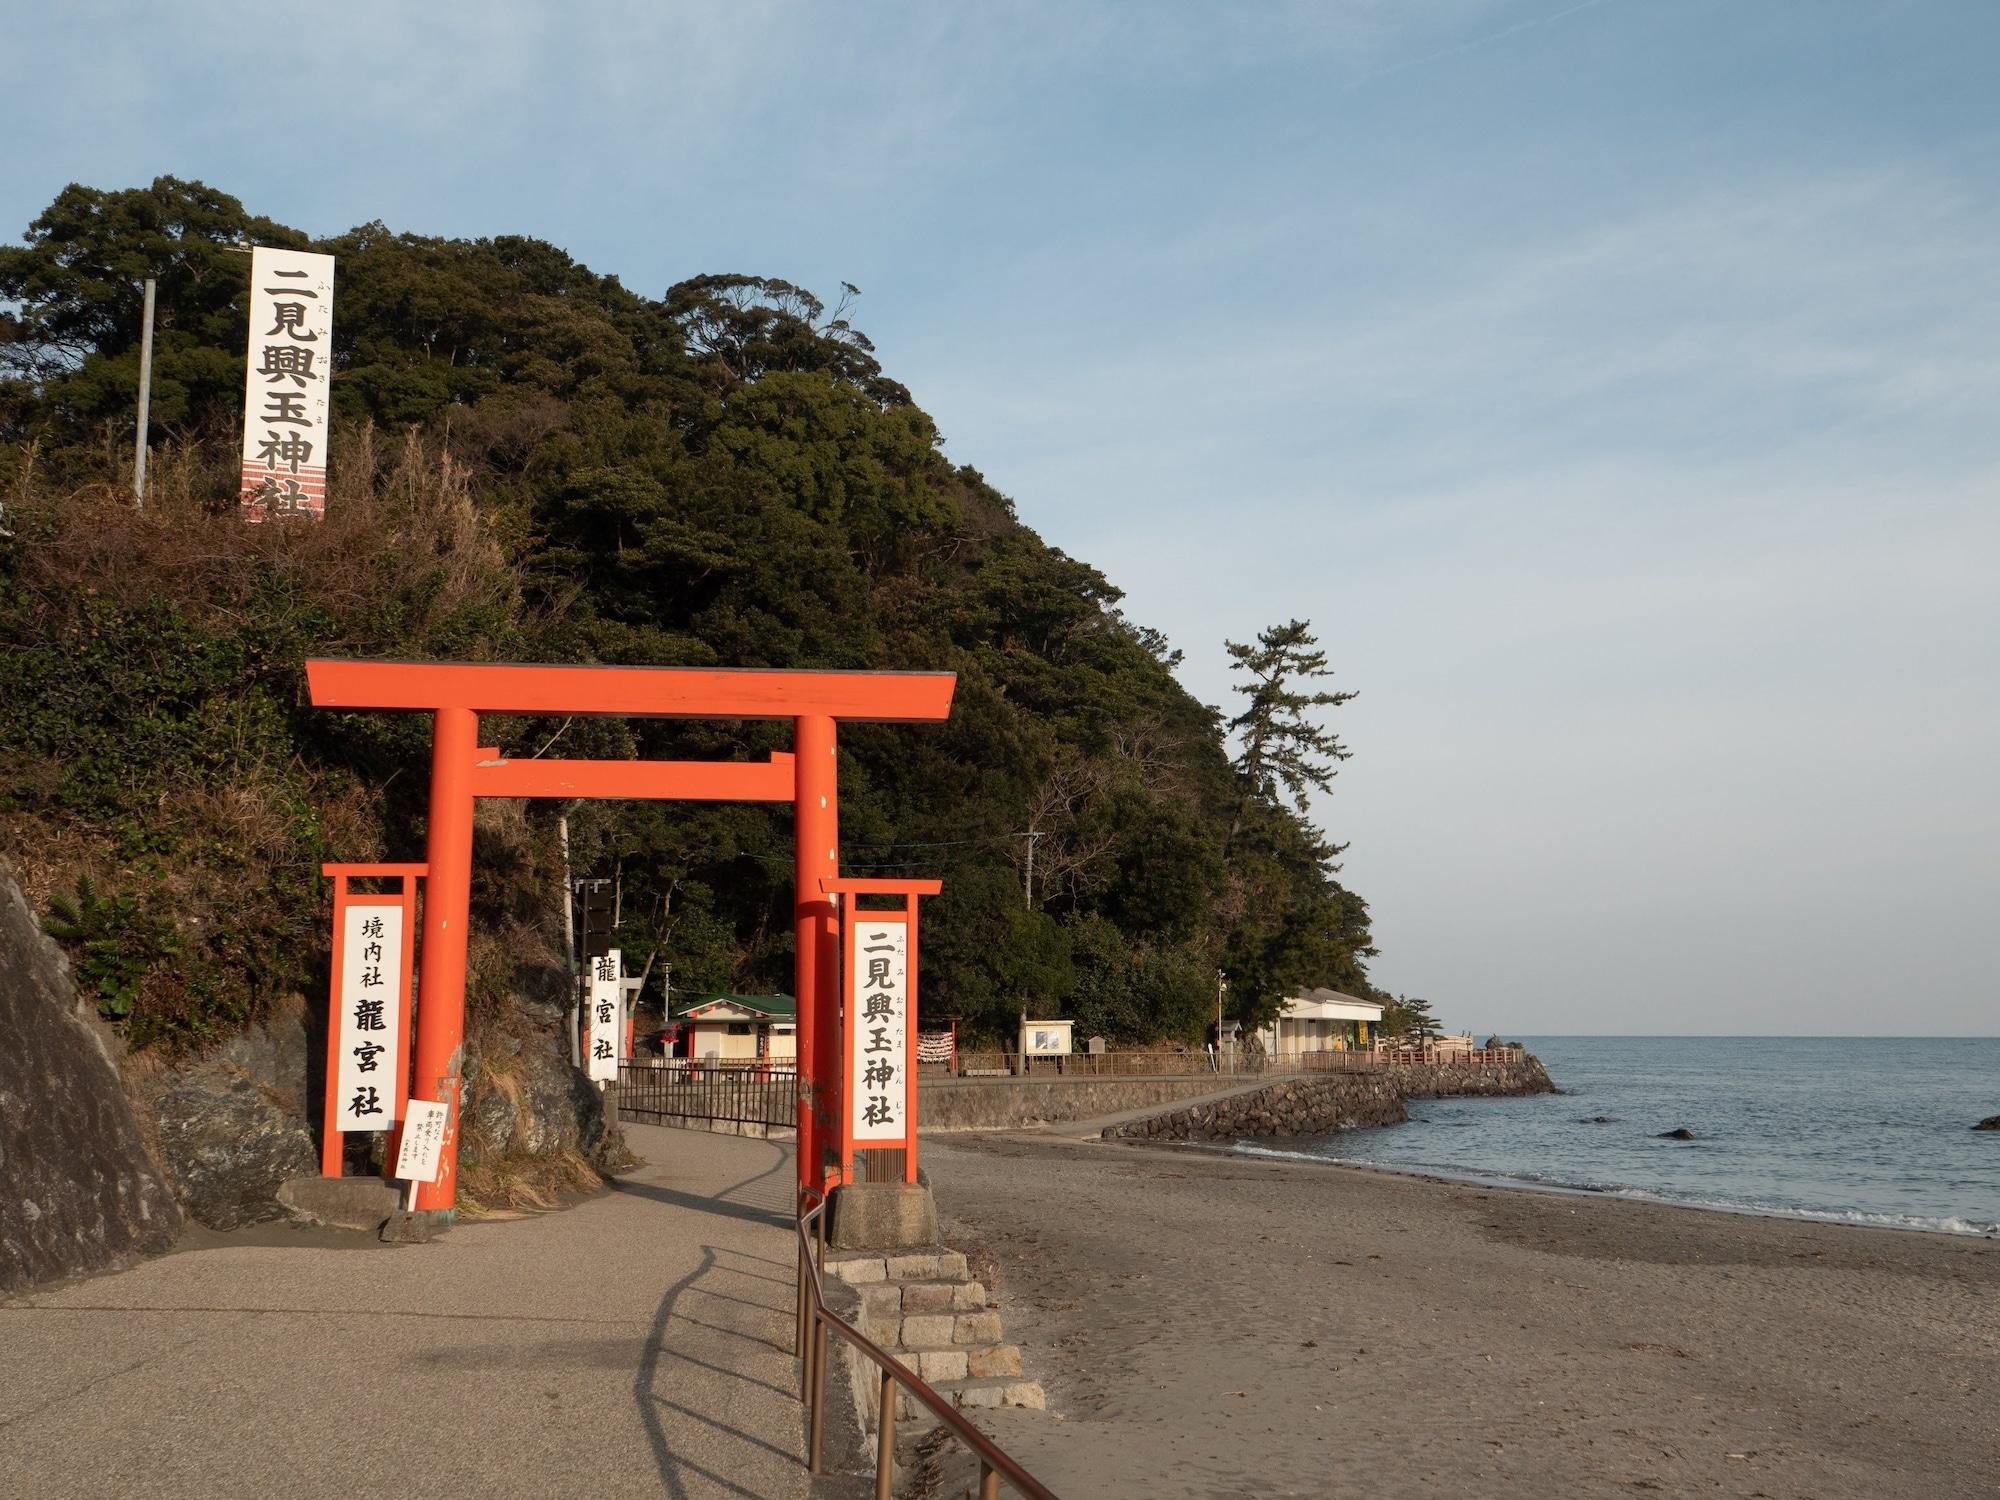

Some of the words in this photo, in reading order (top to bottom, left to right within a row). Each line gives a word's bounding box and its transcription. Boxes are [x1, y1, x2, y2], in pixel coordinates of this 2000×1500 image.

[252, 270, 319, 518] 二見興玉神社
[593, 957, 617, 1061] 龍宮社
[861, 932, 896, 1128] 二見興玉神社
